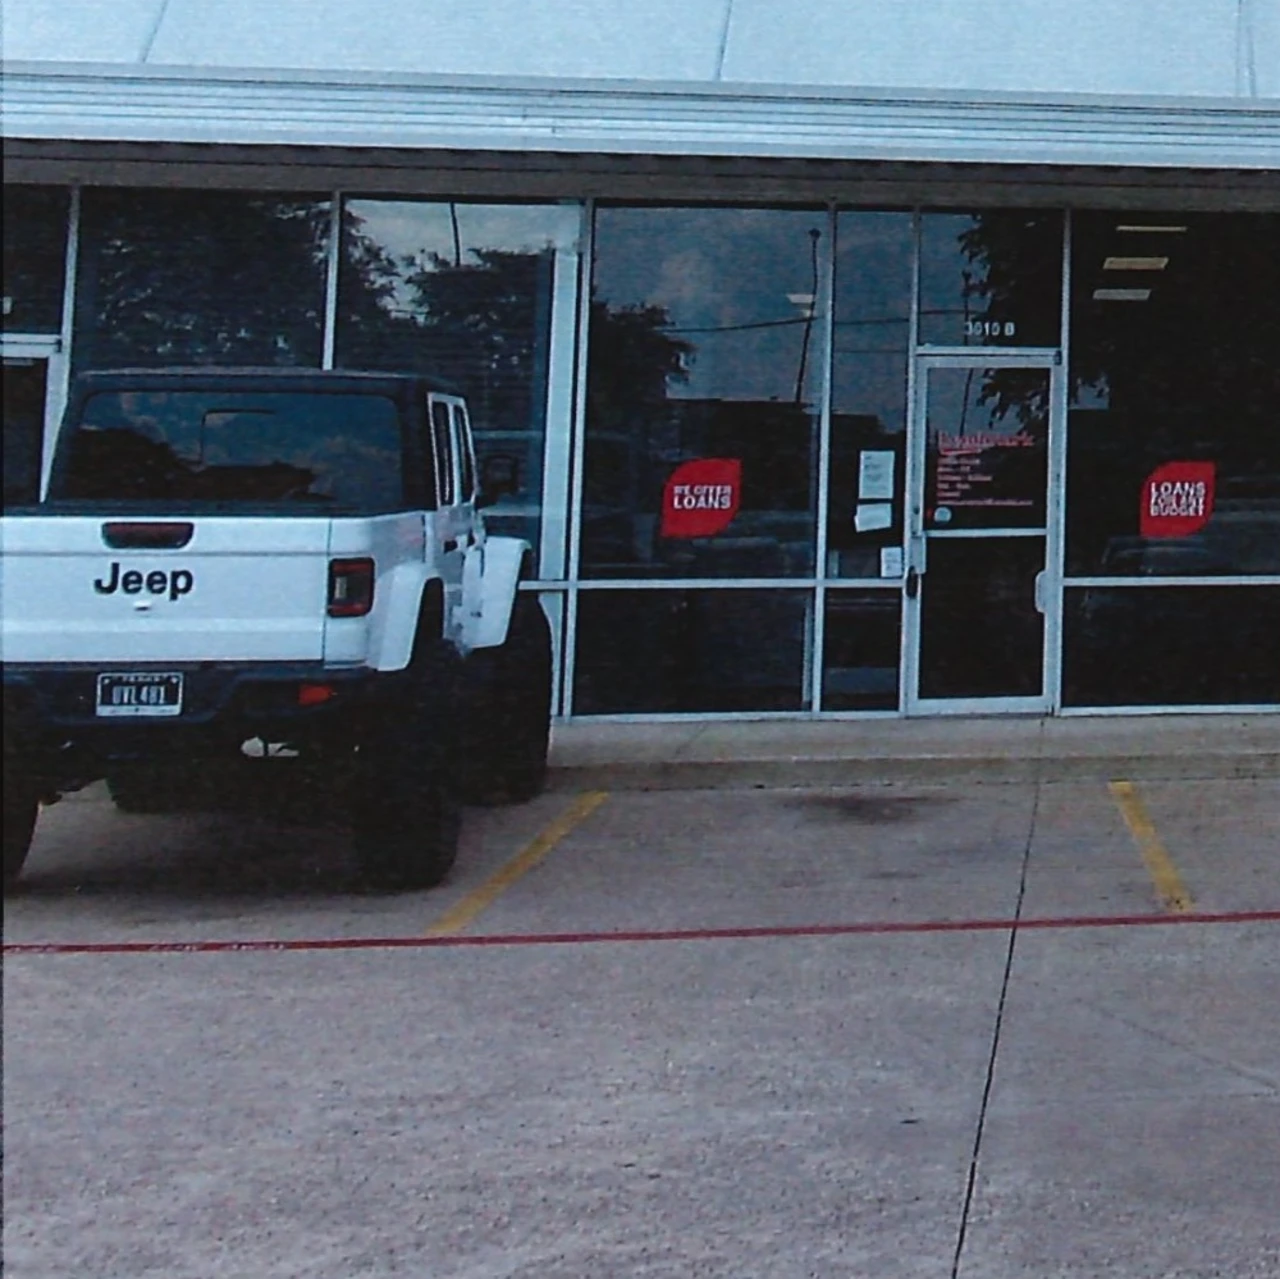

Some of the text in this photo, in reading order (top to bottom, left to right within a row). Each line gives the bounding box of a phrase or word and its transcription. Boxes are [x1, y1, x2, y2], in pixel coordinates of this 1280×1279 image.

[1151, 482, 1205, 496] LOANS
[674, 495, 732, 510] LOANS
[94, 562, 193, 601] Jeep
